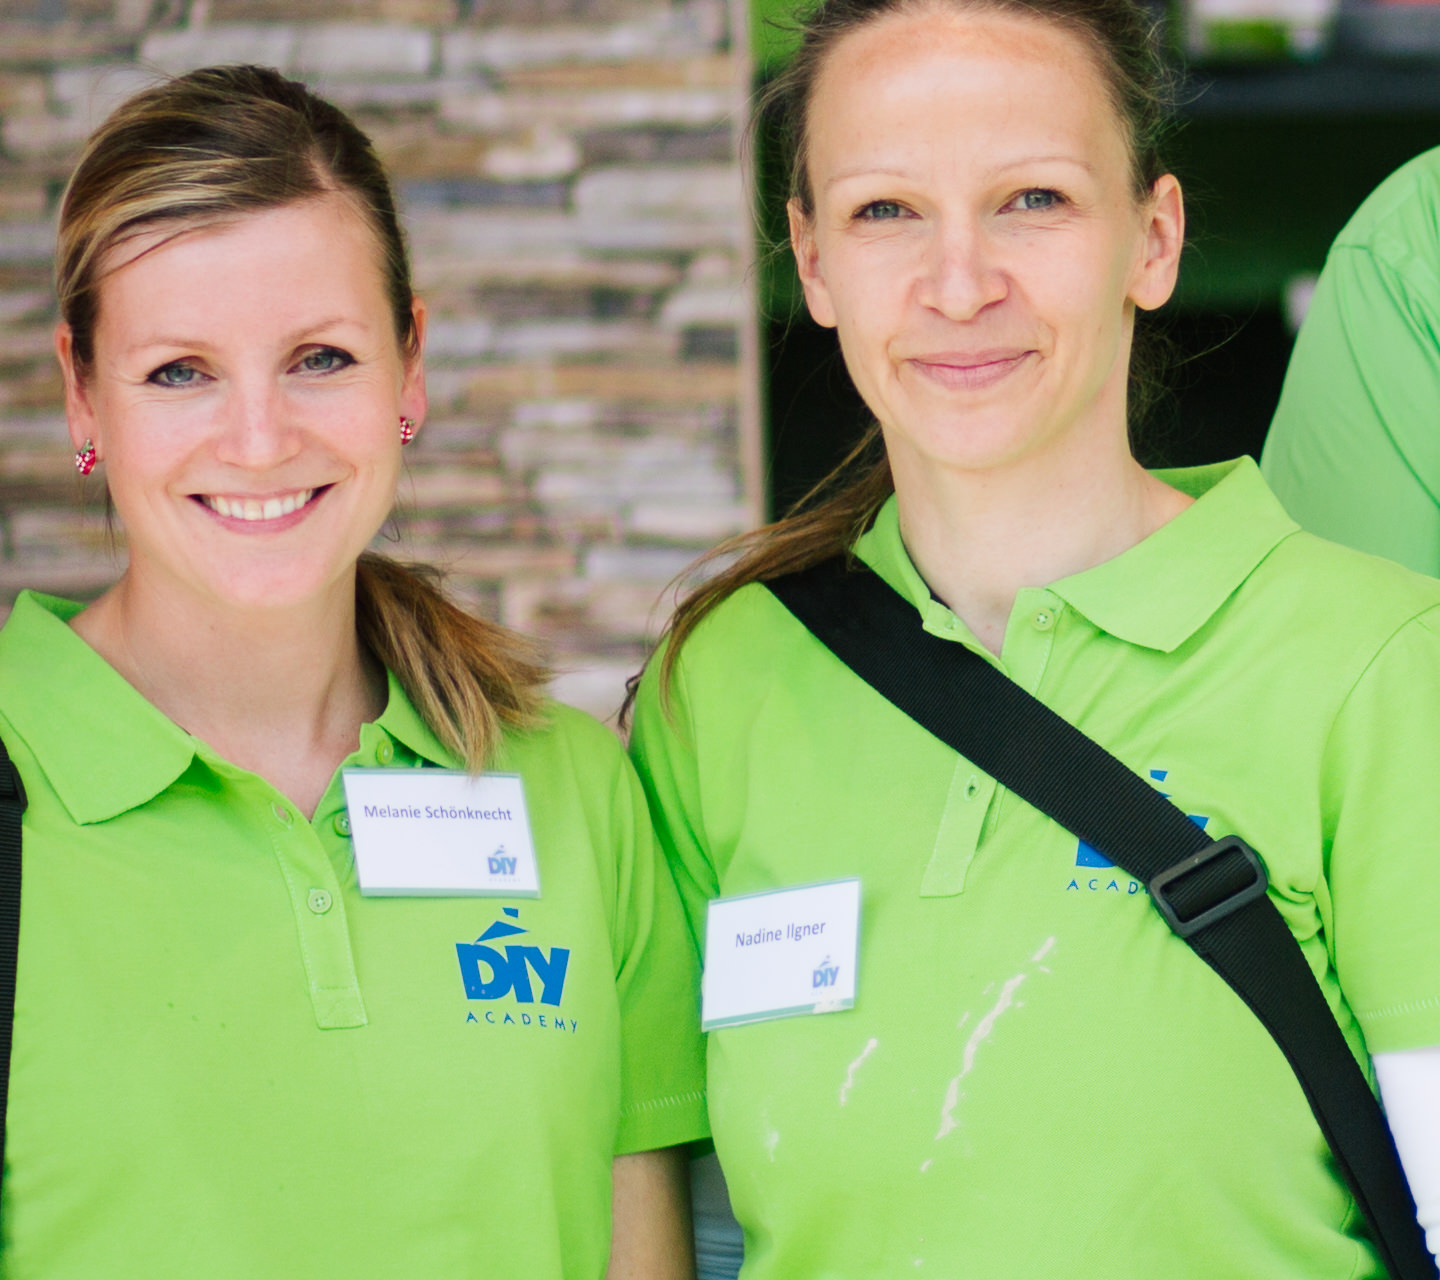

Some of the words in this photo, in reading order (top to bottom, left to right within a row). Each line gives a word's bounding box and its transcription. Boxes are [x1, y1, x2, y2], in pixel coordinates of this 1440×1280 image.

[364, 805, 421, 819] Melanie
[425, 805, 512, 821] Schönknecht
[487, 856, 517, 876] DIY
[1066, 879, 1149, 895] ACAD
[735, 928, 782, 948] Nadine
[456, 942, 570, 1007] DIY
[812, 966, 840, 989] DIY
[465, 1011, 578, 1034] ACADEMY
